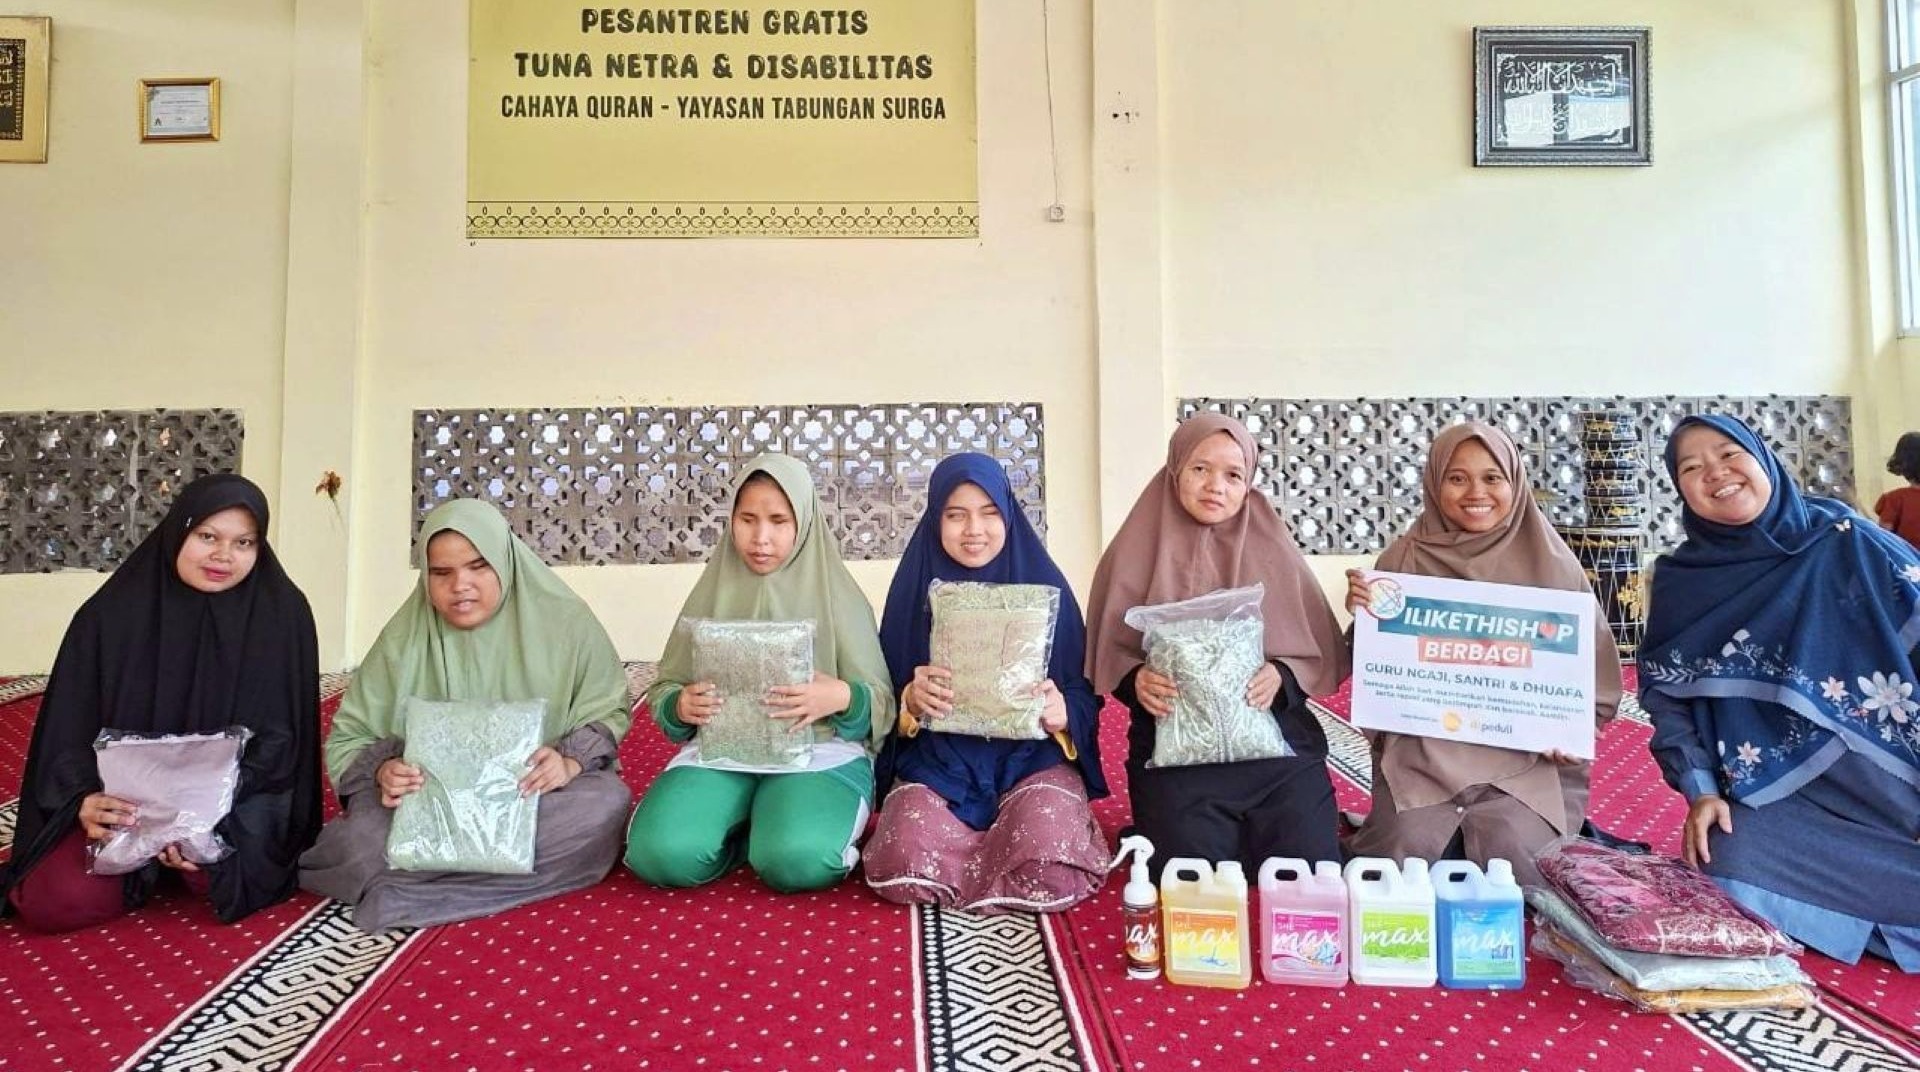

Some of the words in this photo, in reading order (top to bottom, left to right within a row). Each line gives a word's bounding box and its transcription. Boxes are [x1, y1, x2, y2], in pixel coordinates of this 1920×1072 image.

[581, 8, 749, 35] PESANTREN
[763, 10, 868, 36] GRATIS
[514, 52, 593, 78] TUNA
[606, 53, 699, 79] NETRA
[712, 53, 734, 79] &
[747, 54, 932, 80] DISABILITAS
[501, 95, 579, 118] CAHAYA
[587, 95, 653, 120] QURAN
[677, 96, 764, 120] YAYASAN
[771, 97, 875, 120] TABUNGAN
[882, 97, 946, 120] SURGA
[1424, 641, 1529, 666] BERBAGI
[1365, 662, 1403, 676] GURU
[1407, 667, 1451, 684] NGAJI,
[1455, 674, 1505, 689] SANTRI
[1509, 681, 1519, 691] &
[1523, 682, 1585, 700] DHUAFA
[1361, 927, 1430, 948] max
